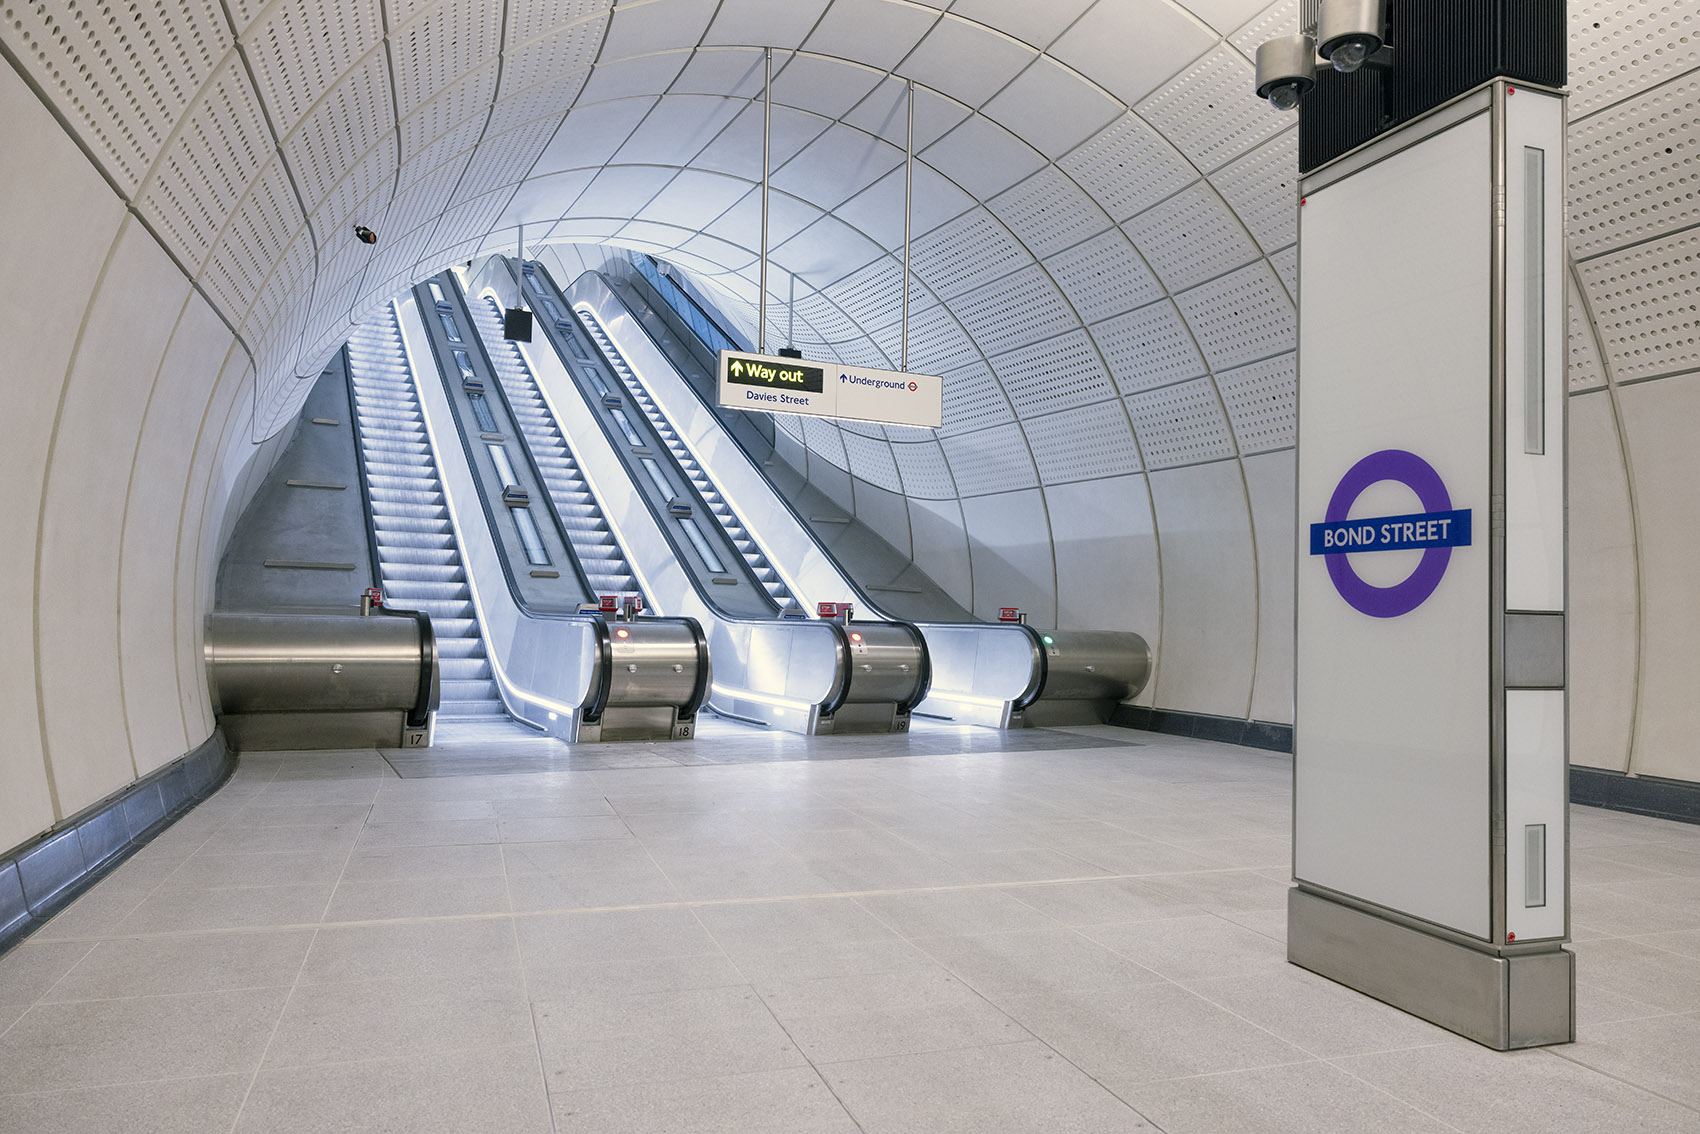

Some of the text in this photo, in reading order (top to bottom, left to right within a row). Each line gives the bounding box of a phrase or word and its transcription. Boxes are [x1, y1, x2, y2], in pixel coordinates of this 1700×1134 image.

[746, 363, 804, 383] Way out
[849, 375, 905, 390] Underground
[746, 391, 809, 406] Davies Street
[1324, 519, 1451, 547] BOND STREET
[678, 727, 690, 737] 18
[896, 721, 906, 730] 19
[410, 734, 423, 745] 17
